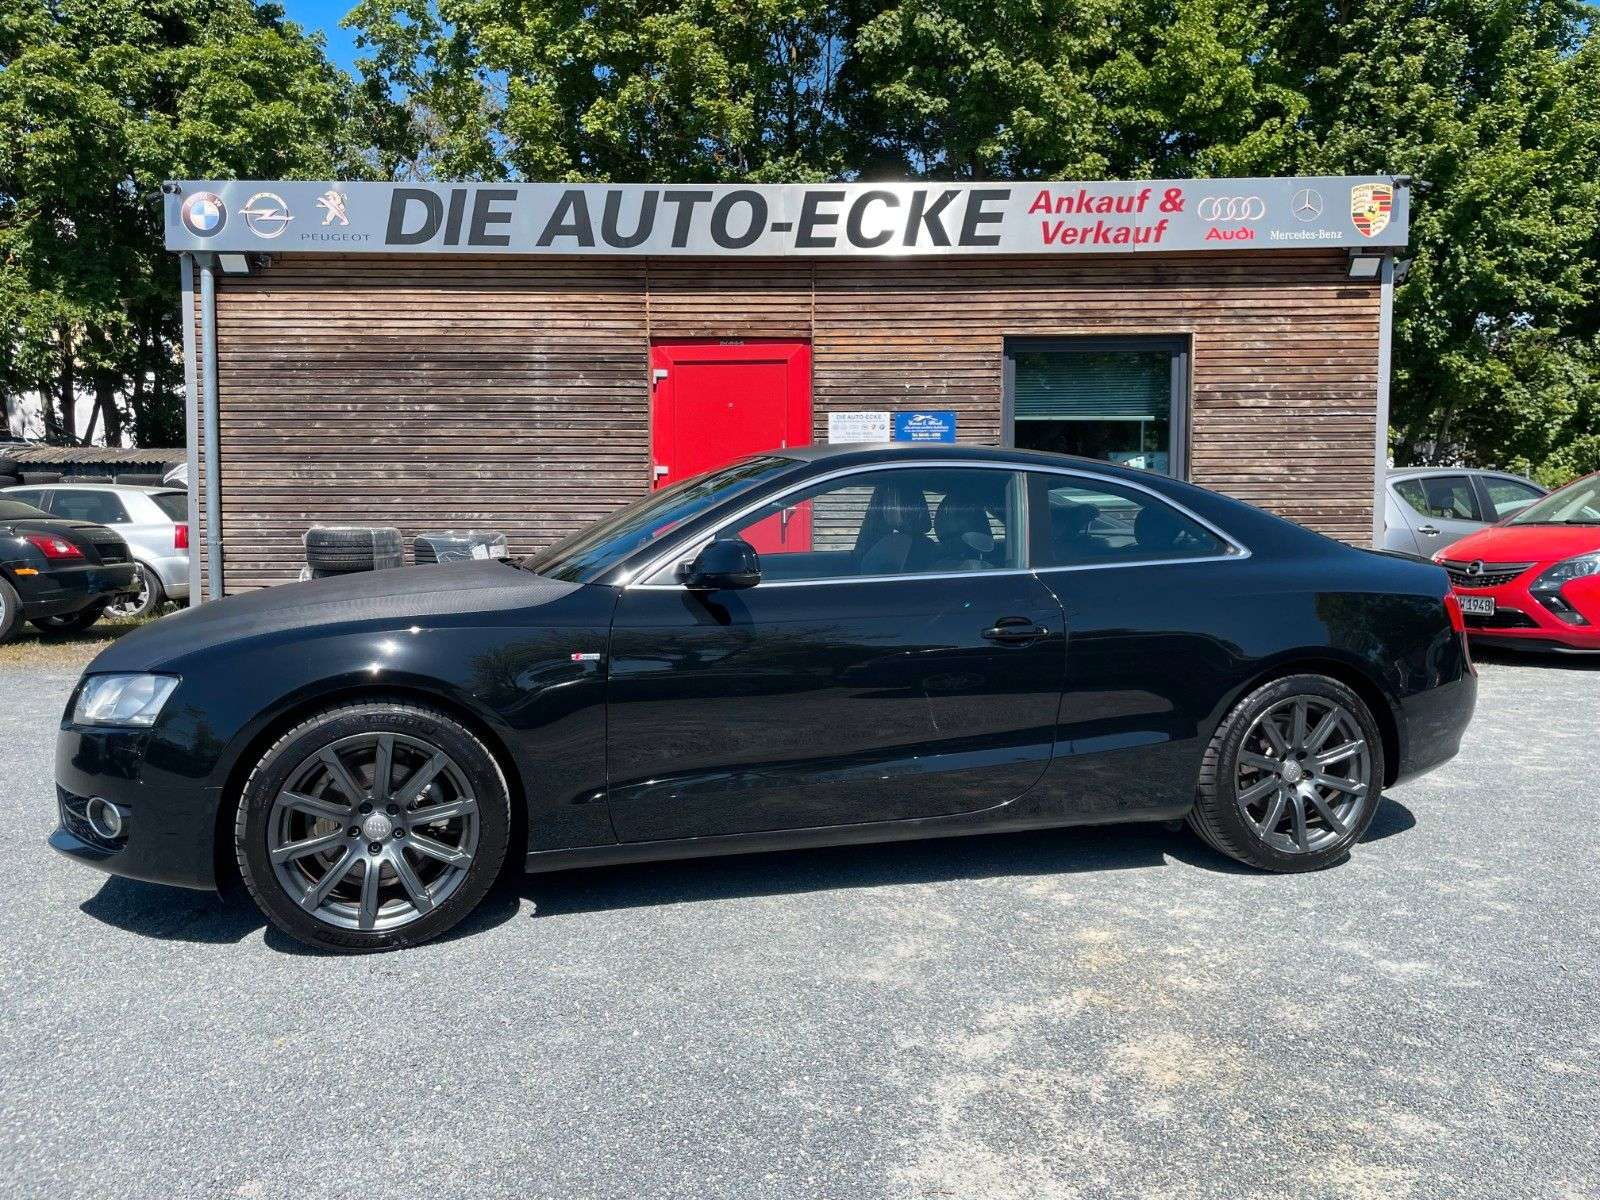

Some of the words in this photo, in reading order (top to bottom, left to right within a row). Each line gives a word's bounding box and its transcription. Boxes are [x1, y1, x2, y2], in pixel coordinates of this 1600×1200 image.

[1028, 188, 1152, 215] Ankauf
[1158, 187, 1185, 214] &
[384, 187, 518, 247] DIE
[535, 189, 1011, 249] AUTO-ECKE
[300, 233, 370, 242] PEUGEOT
[1041, 218, 1169, 246] Verkauf
[1205, 226, 1256, 241] Audi
[1269, 229, 1344, 241] Mercedes-Benz
